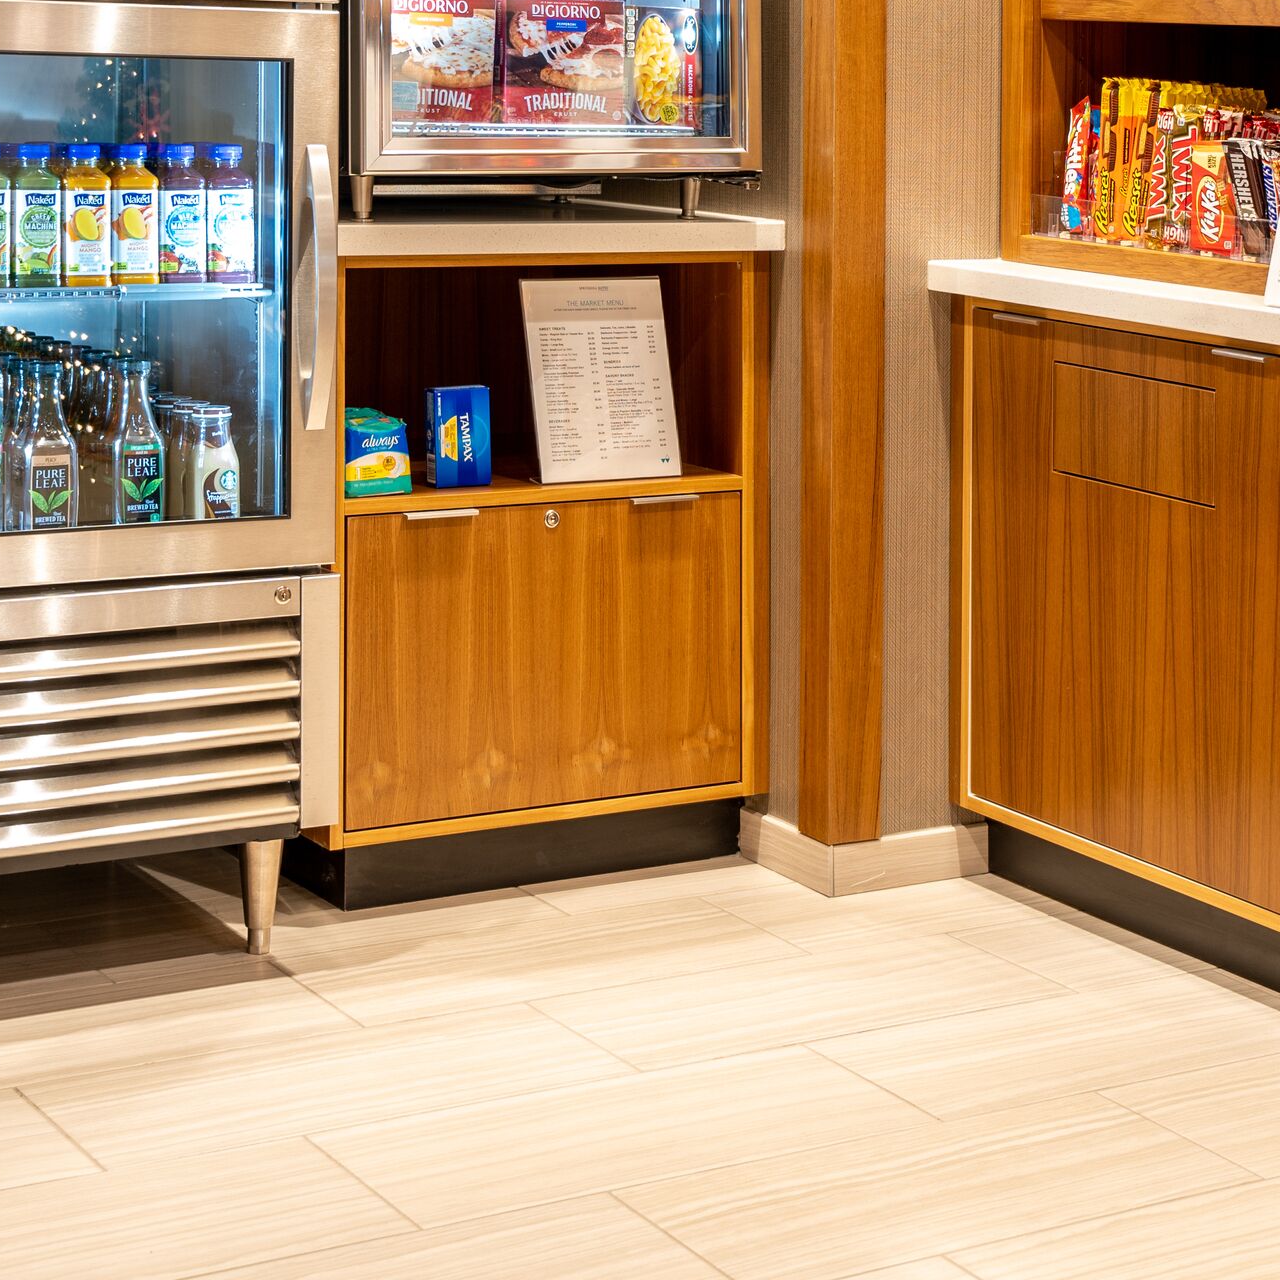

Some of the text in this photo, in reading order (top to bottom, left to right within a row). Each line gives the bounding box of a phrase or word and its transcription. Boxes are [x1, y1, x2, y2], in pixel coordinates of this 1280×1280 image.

[524, 92, 607, 113] TRADITIONAL
[1146, 136, 1166, 220] TWIX
[1172, 125, 1198, 221] TWIX
[1230, 154, 1257, 222] HERSHEY'S
[1263, 165, 1278, 231] SNICKERS
[1095, 169, 1110, 234] Reese's
[1123, 169, 1142, 236] Reese's
[362, 434, 401, 450] always
[458, 412, 473, 462] TAMPAX
[36, 469, 66, 479] PURE
[36, 479, 66, 489] LEAF
[128, 457, 156, 468] PURE
[128, 468, 157, 477] LEAF
